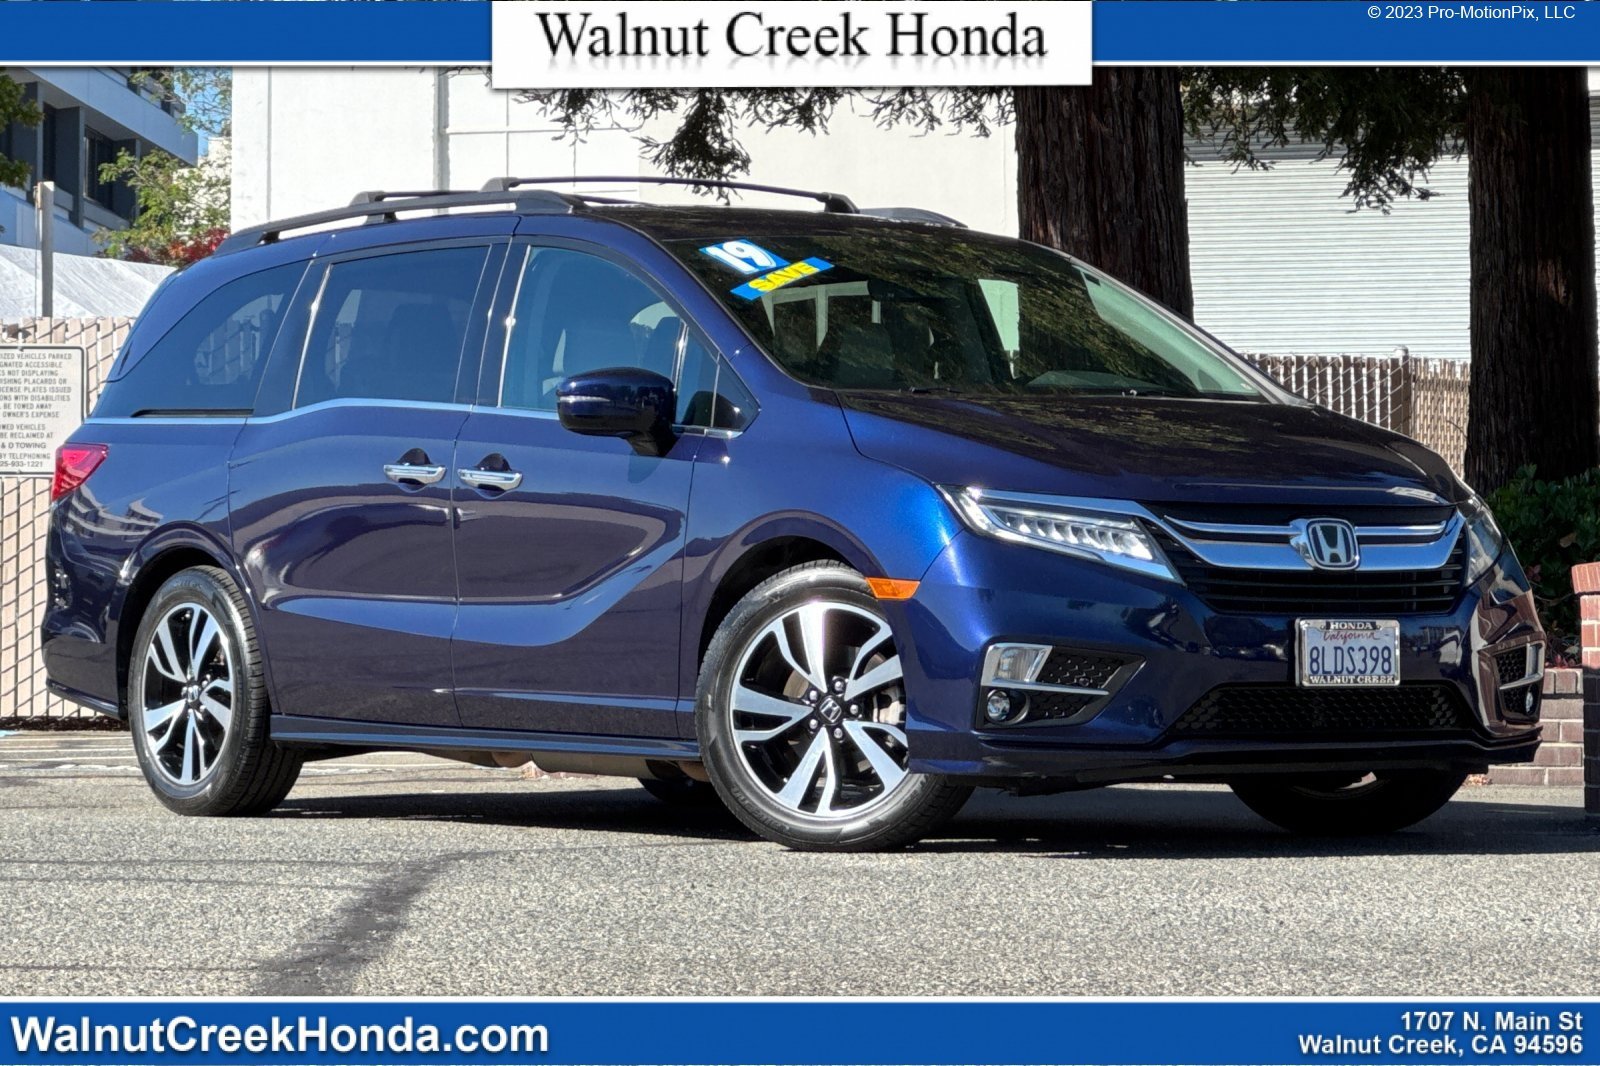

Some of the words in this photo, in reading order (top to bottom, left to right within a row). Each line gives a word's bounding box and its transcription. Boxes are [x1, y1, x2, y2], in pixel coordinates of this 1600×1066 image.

[704, 240, 777, 275] 19
[748, 260, 821, 292] SAVE
[1330, 621, 1374, 630] HONDA
[1322, 630, 1382, 645] California
[1309, 645, 1393, 675] 8LDS398
[1309, 675, 1356, 684] WALNUT
[1357, 675, 1395, 684] CREEK
